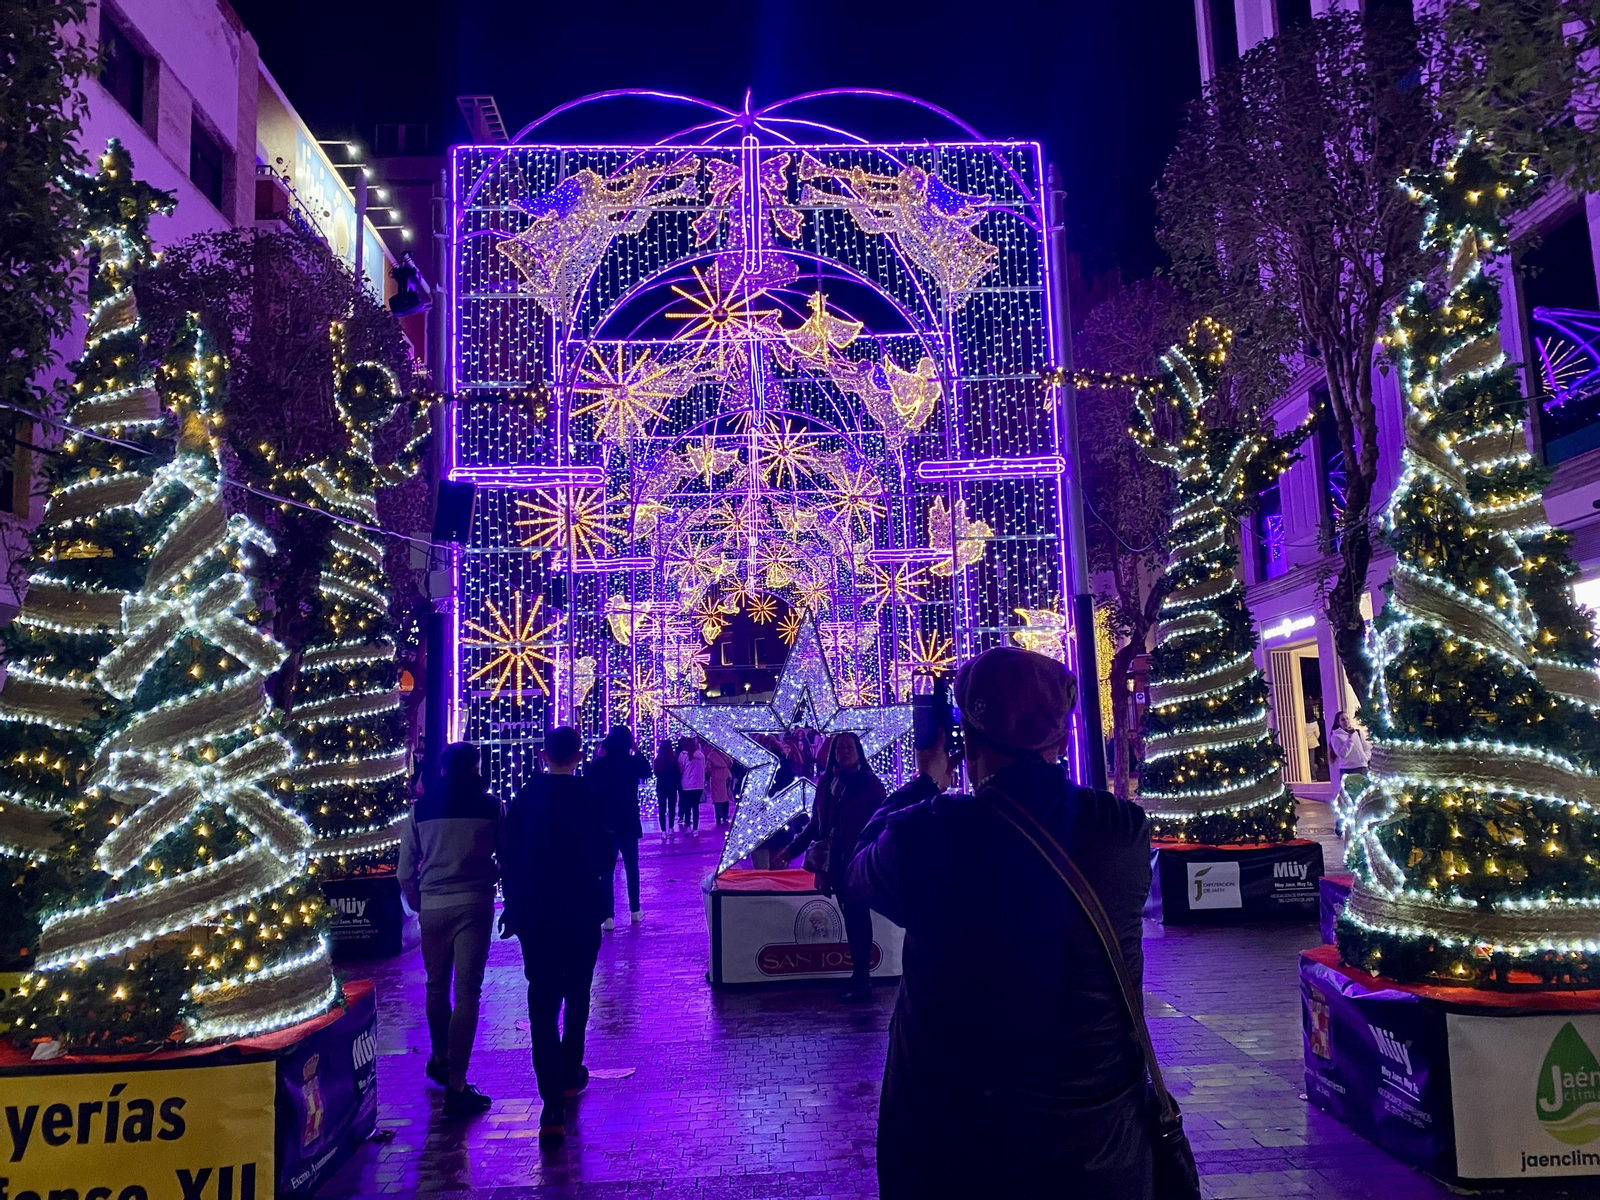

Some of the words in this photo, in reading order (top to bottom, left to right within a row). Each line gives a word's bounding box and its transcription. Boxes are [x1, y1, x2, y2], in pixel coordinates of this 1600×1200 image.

[1274, 861, 1308, 880] Müy
[763, 953, 812, 970] SAN
[1368, 1024, 1413, 1076] Müy
[4, 1082, 188, 1163] yerías
